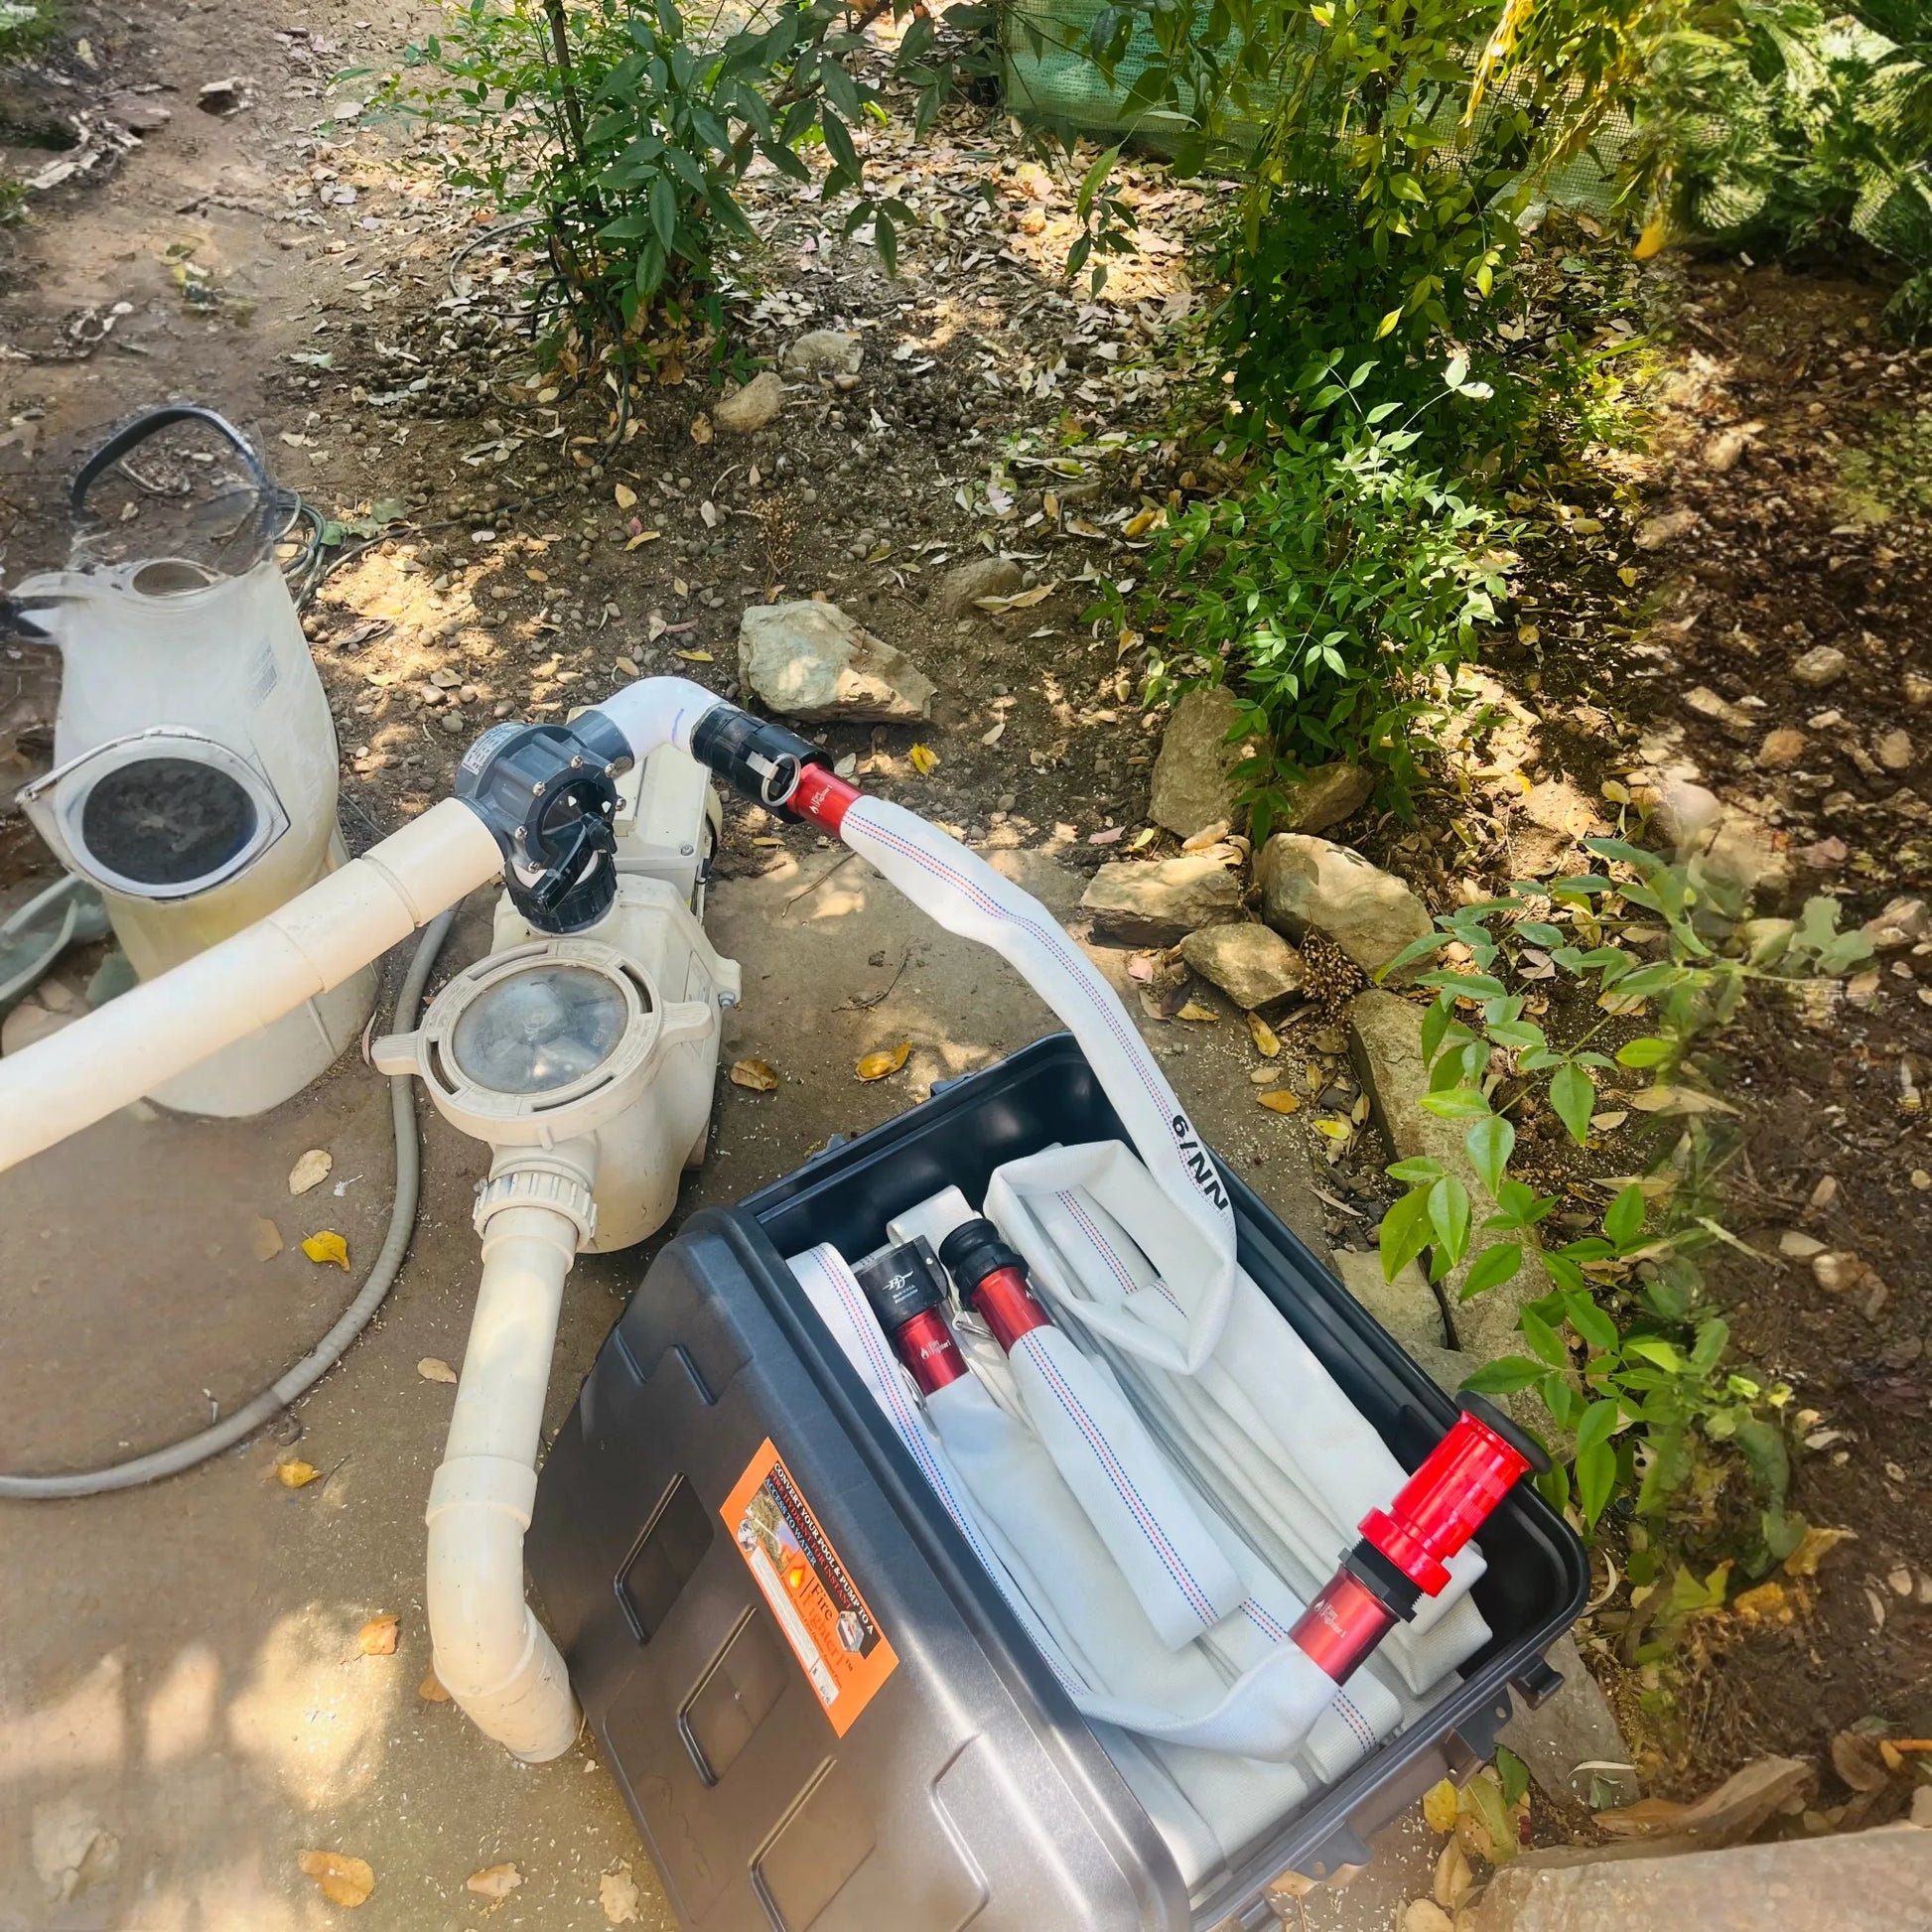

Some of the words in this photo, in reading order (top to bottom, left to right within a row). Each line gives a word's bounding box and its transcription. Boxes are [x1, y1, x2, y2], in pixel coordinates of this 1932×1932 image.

[764, 1477, 786, 1514] ACCESS
[785, 1514, 795, 1528] TO
[793, 1528, 817, 1567] WATER
[769, 1470, 784, 1494] FIRE
[782, 1494, 811, 1541] HYDRANT
[810, 1542, 825, 1565] FOR
[823, 1565, 851, 1609] INSTANT
[773, 1462, 803, 1510] CONVERT
[800, 1508, 819, 1538] YOUR
[816, 1538, 837, 1568] POOL
[834, 1566, 841, 1576] &
[839, 1576, 860, 1607] PUMP
[859, 1606, 869, 1623] TO
[866, 1624, 874, 1634] A
[811, 1584, 833, 1620] Fire
